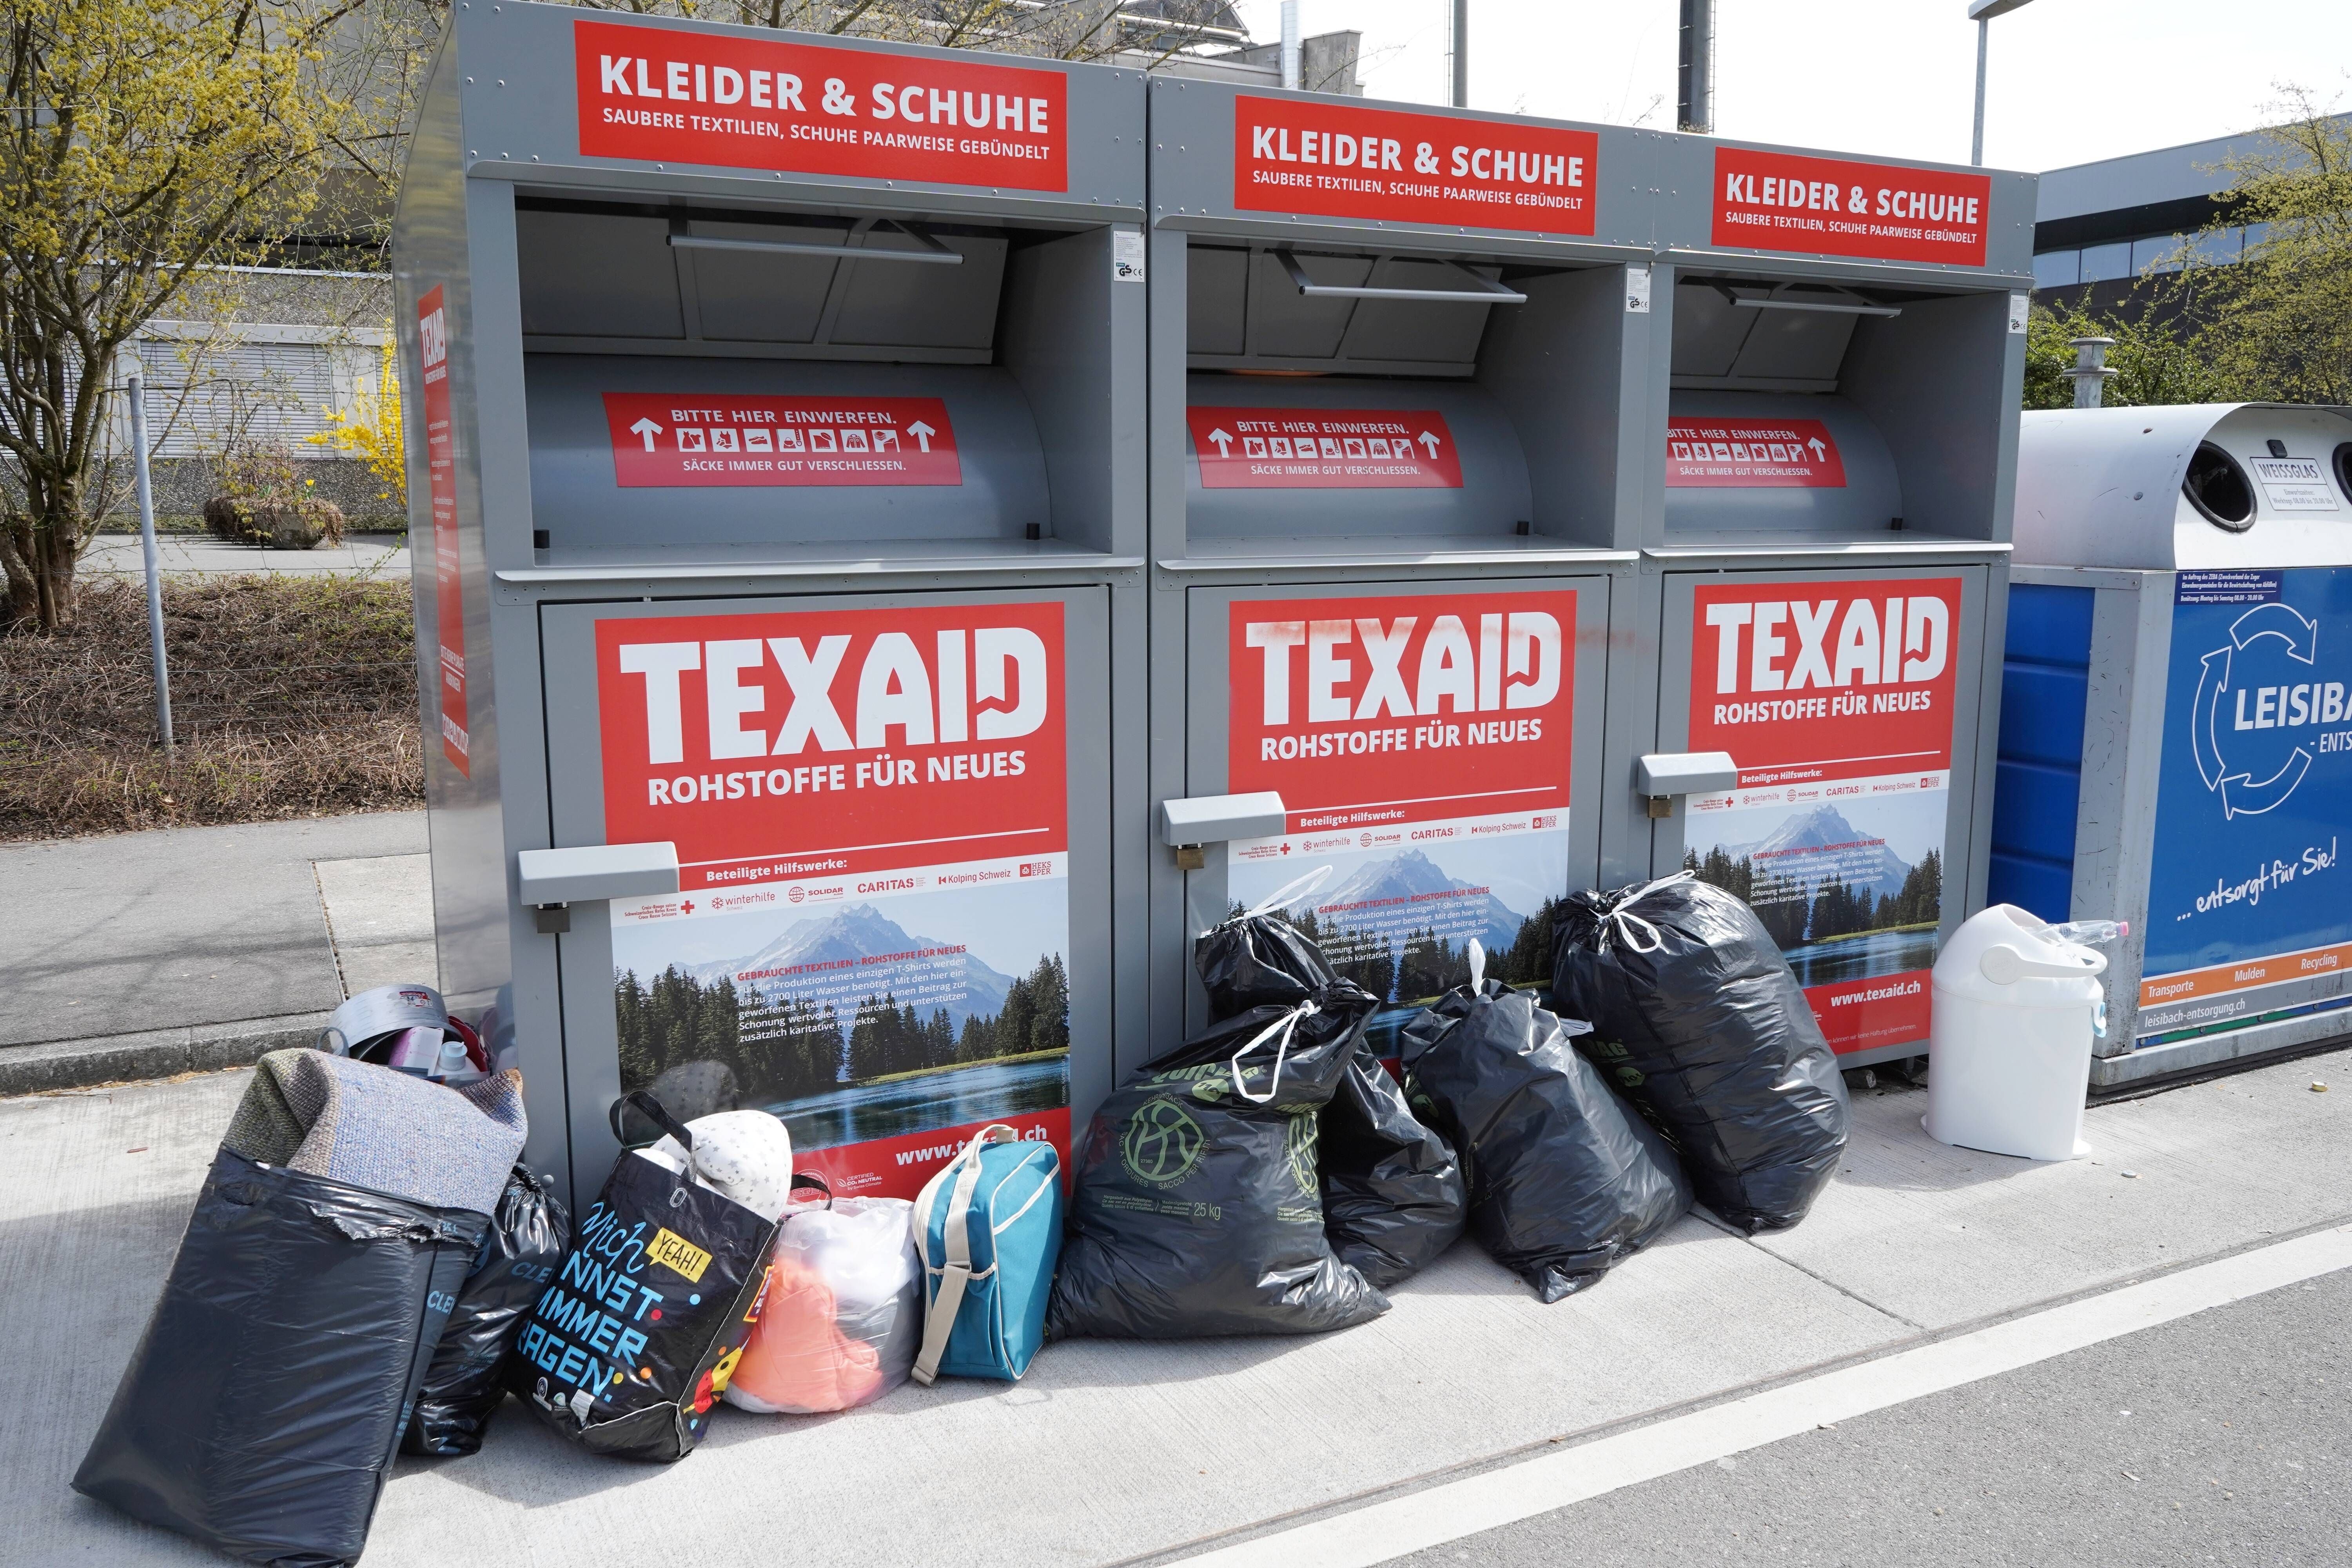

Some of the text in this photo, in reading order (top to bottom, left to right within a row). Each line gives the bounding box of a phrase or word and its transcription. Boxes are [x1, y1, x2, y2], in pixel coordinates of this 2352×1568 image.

[601, 55, 1047, 133] KLEIDER & SCHUHE
[604, 108, 1049, 159] SAUBERE TEXTILIEN, SCHUHE PAARWEISE GEBÜNDELT
[1254, 126, 1583, 187] KLEIDER & SCHUHE
[1254, 171, 1582, 209] SAUBERE TEXTILIEN, SCHUHE PAARWEISE GEBÜNDELT
[1727, 173, 1978, 223] KLEIDER & SCHUHE
[1726, 212, 1976, 243] SAUBERE TEXTILIEN, SCHUHE PAARWEISE GEBÜNDELT
[420, 307, 446, 368] TEXAID
[671, 410, 897, 423] BITTE HIER EINWERFEN.
[1237, 421, 1409, 434] BITTE HIER EINWERFEN.
[1668, 429, 1800, 439] BITTE HIER EINWERFEN.
[684, 459, 906, 470] SÄCKE IMMER GUT VERSCHLIESSEN.
[1251, 464, 1282, 474] SÄCKE
[1345, 466, 1420, 474] VERSCHLIESSEN.
[1680, 466, 1704, 475] SÄCKE
[2258, 464, 2319, 479] WEISSGLAS
[1706, 597, 1948, 693] TEXAID
[1246, 612, 1561, 725] TEXAID
[620, 628, 1047, 764] TEXAID
[1714, 691, 1931, 724] ROHSTOFFE FÜR NEUES
[1262, 719, 1541, 760] ROHSTOFFE FÜR NEUES
[649, 751, 1025, 805] ROHSTOFFE FÜR NEUES
[1742, 769, 1822, 783] Beteiligte Hilfswerke:
[1301, 810, 1405, 827] Beteiligte Hilfswerke:
[707, 859, 847, 881] Beteiligte Hilfswerke:
[949, 869, 1010, 884] Kolping Schweiz
[2197, 863, 2269, 913] entsorgt
[2270, 860, 2298, 889] für
[2303, 836, 2336, 875] Sie!
[726, 892, 775, 905] winterhilfe
[857, 878, 914, 893] CARITAS
[737, 966, 803, 981] GEBRAUCHTE
[805, 960, 853, 973] TEXTILIEN
[861, 952, 915, 965] ROHSTOFFE
[917, 949, 935, 957] FÜR
[937, 945, 966, 955] NEUES
[739, 958, 966, 993] Für die Produktion eines einzigen T-Shirts werden
[2235, 967, 2265, 982] Mulden
[2301, 955, 2337, 970] Recycling
[738, 998, 752, 1006] bis
[768, 992, 790, 1003] 2700
[793, 990, 814, 999] Liter
[816, 985, 850, 995] Wasser
[852, 979, 893, 991] benötigt.
[895, 976, 910, 985] Mit
[912, 974, 928, 983] den
[931, 972, 949, 981] hier
[950, 969, 966, 978] ein-
[738, 1005, 796, 1020] geworfenen
[799, 998, 839, 1011] Textilien
[842, 994, 873, 1004] leisten
[875, 991, 888, 1001] Sie
[891, 988, 916, 997] einen
[919, 983, 950, 995] Beitrag
[1831, 981, 1920, 1006] www.texaid.ch
[2149, 981, 2193, 997] Transporte
[739, 993, 967, 1031] Schonung wertvoller Ressourcen und unterstützen
[2144, 998, 2245, 1028] leisibach-entsorgung.ch
[739, 1016, 878, 1043] zusätzlich karitative Projekte.
[896, 1124, 1047, 1165] www.t.ch
[1121, 1159, 1149, 1187] ORDURES
[1158, 1176, 1185, 1190] SACCO
[1185, 1163, 1200, 1178] PER
[1194, 1202, 1220, 1220] 25 kg
[659, 1233, 703, 1276] YEAH!
[536, 1286, 648, 1368] IMMER
